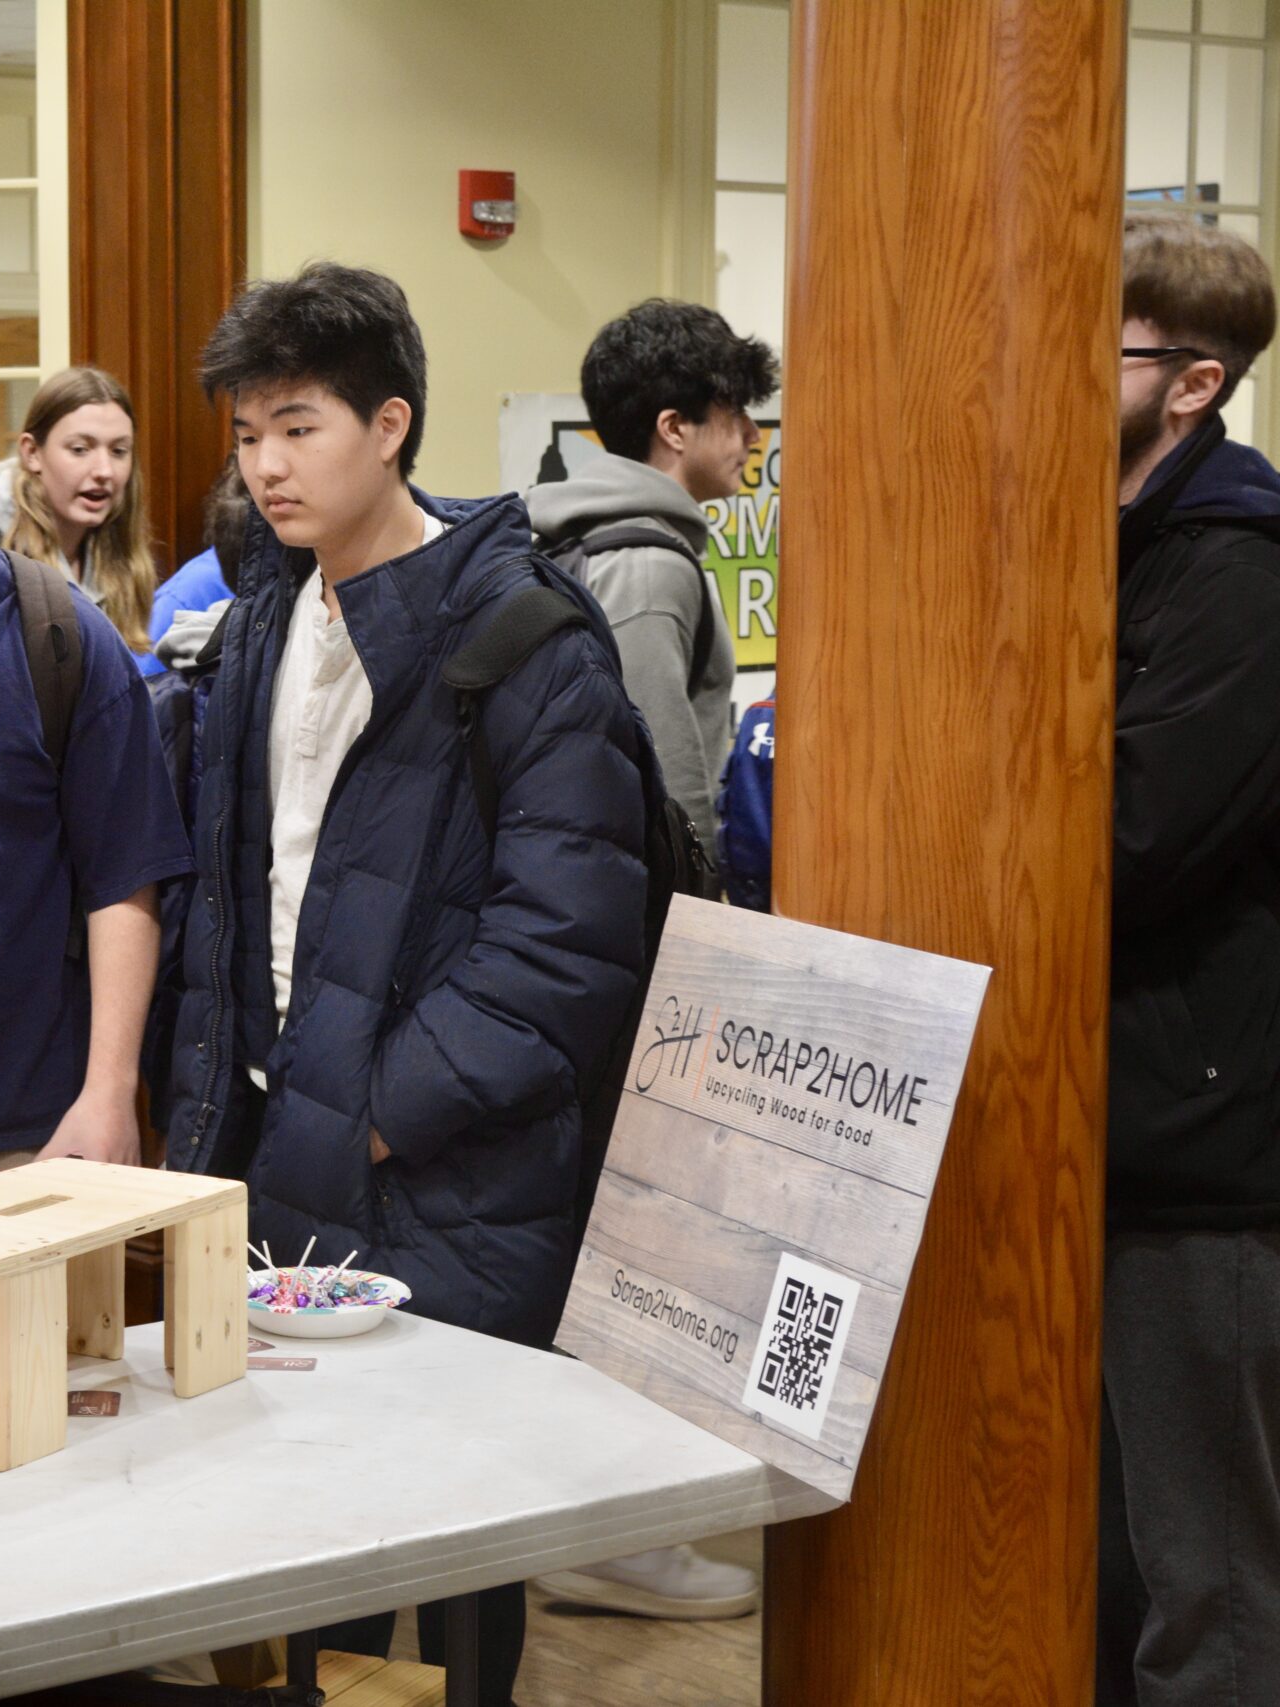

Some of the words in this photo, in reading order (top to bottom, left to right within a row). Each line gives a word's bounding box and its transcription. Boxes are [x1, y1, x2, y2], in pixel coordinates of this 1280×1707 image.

[705, 1076, 767, 1116] Upcycling
[770, 1097, 806, 1125] Wood
[811, 1109, 831, 1132] for
[834, 1119, 873, 1147] Good
[716, 1020, 928, 1126] SCRAP2HOME
[611, 1269, 739, 1364] Scrap2Home.org
